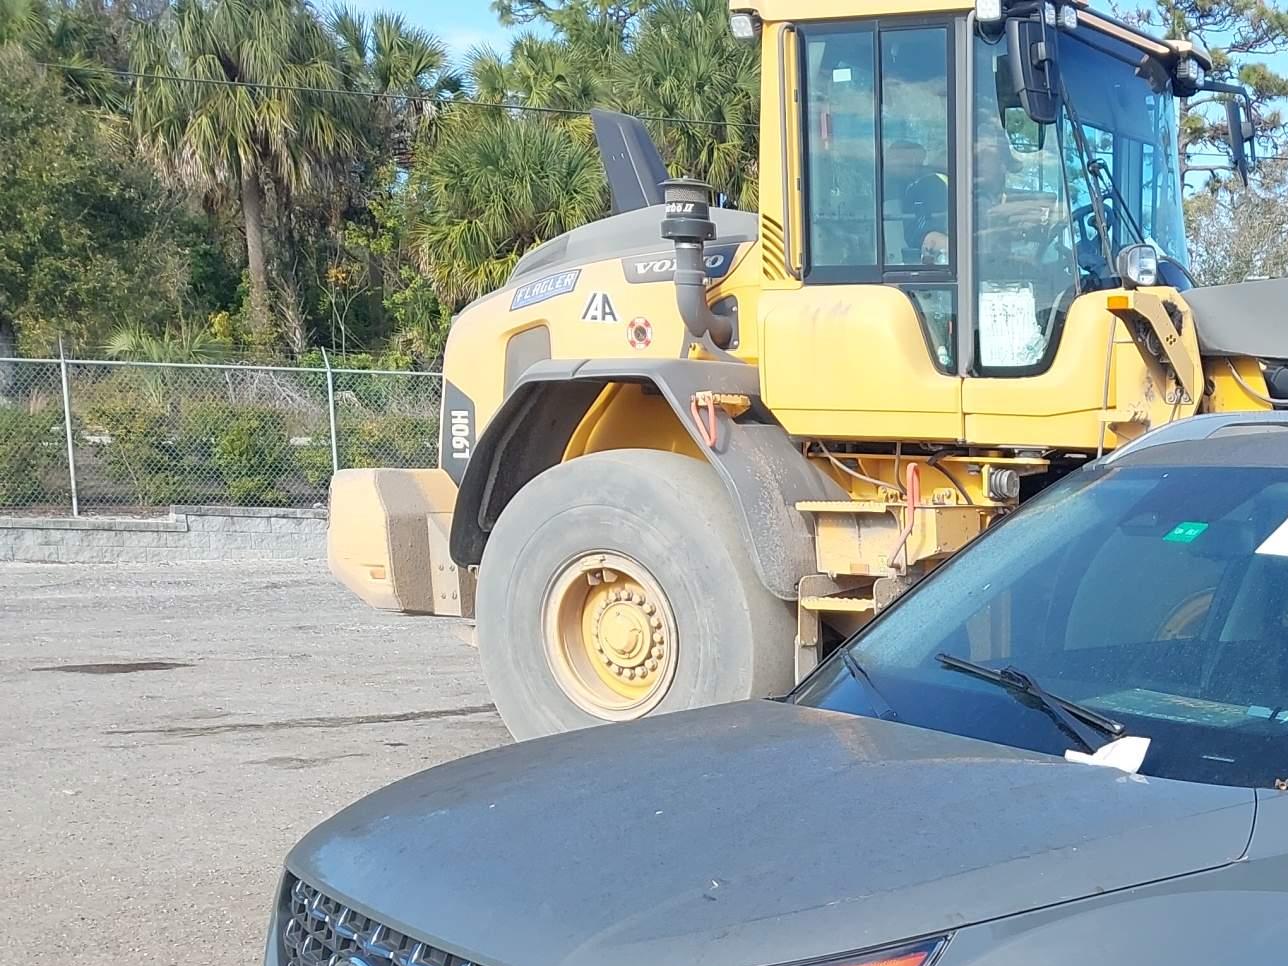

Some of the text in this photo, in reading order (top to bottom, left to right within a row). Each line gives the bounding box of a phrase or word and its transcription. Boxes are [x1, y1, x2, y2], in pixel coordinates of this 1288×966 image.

[634, 254, 725, 274] VOO
[515, 272, 577, 303] FLAGLER
[451, 410, 470, 459] L90H
